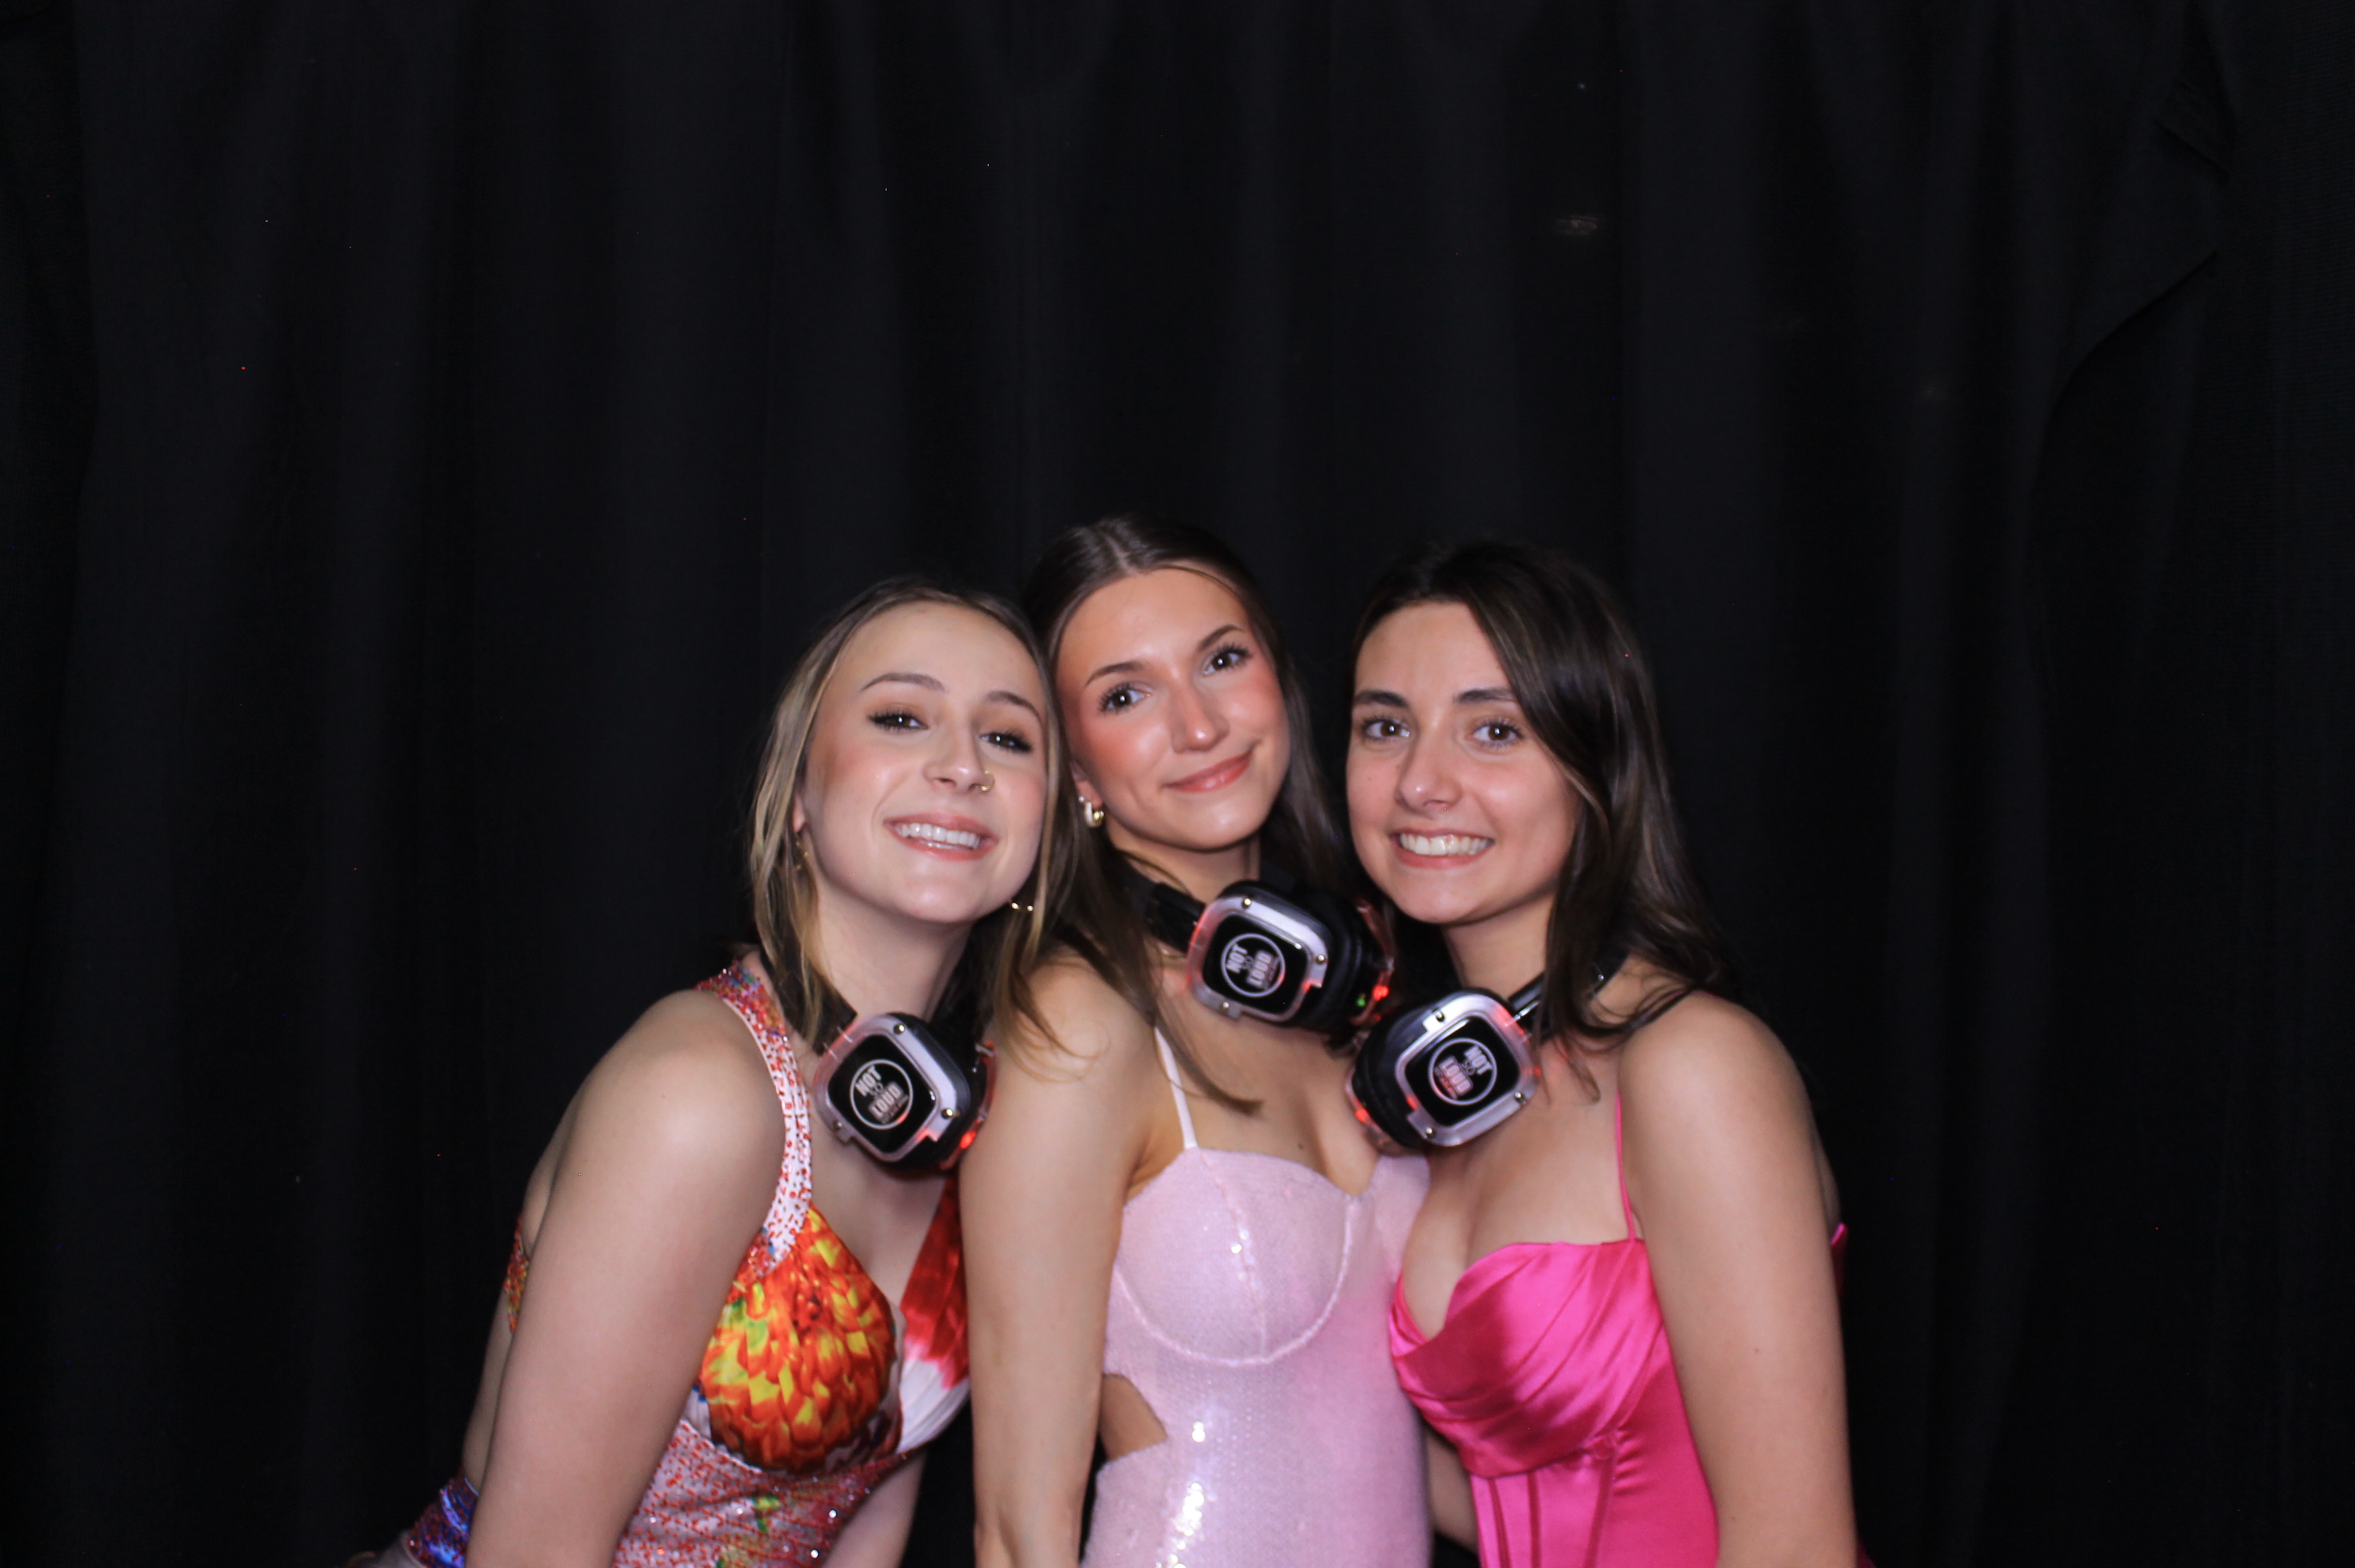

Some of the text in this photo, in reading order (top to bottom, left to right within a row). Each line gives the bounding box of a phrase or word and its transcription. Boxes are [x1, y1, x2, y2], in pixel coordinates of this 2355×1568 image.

[1226, 943, 1248, 974] NOT
[1248, 951, 1273, 986] LOUD
[1438, 1056, 1471, 1094] LOUD
[1464, 1046, 1493, 1075] NOT
[855, 1065, 882, 1097] NOT
[869, 1083, 903, 1120] LOUD
